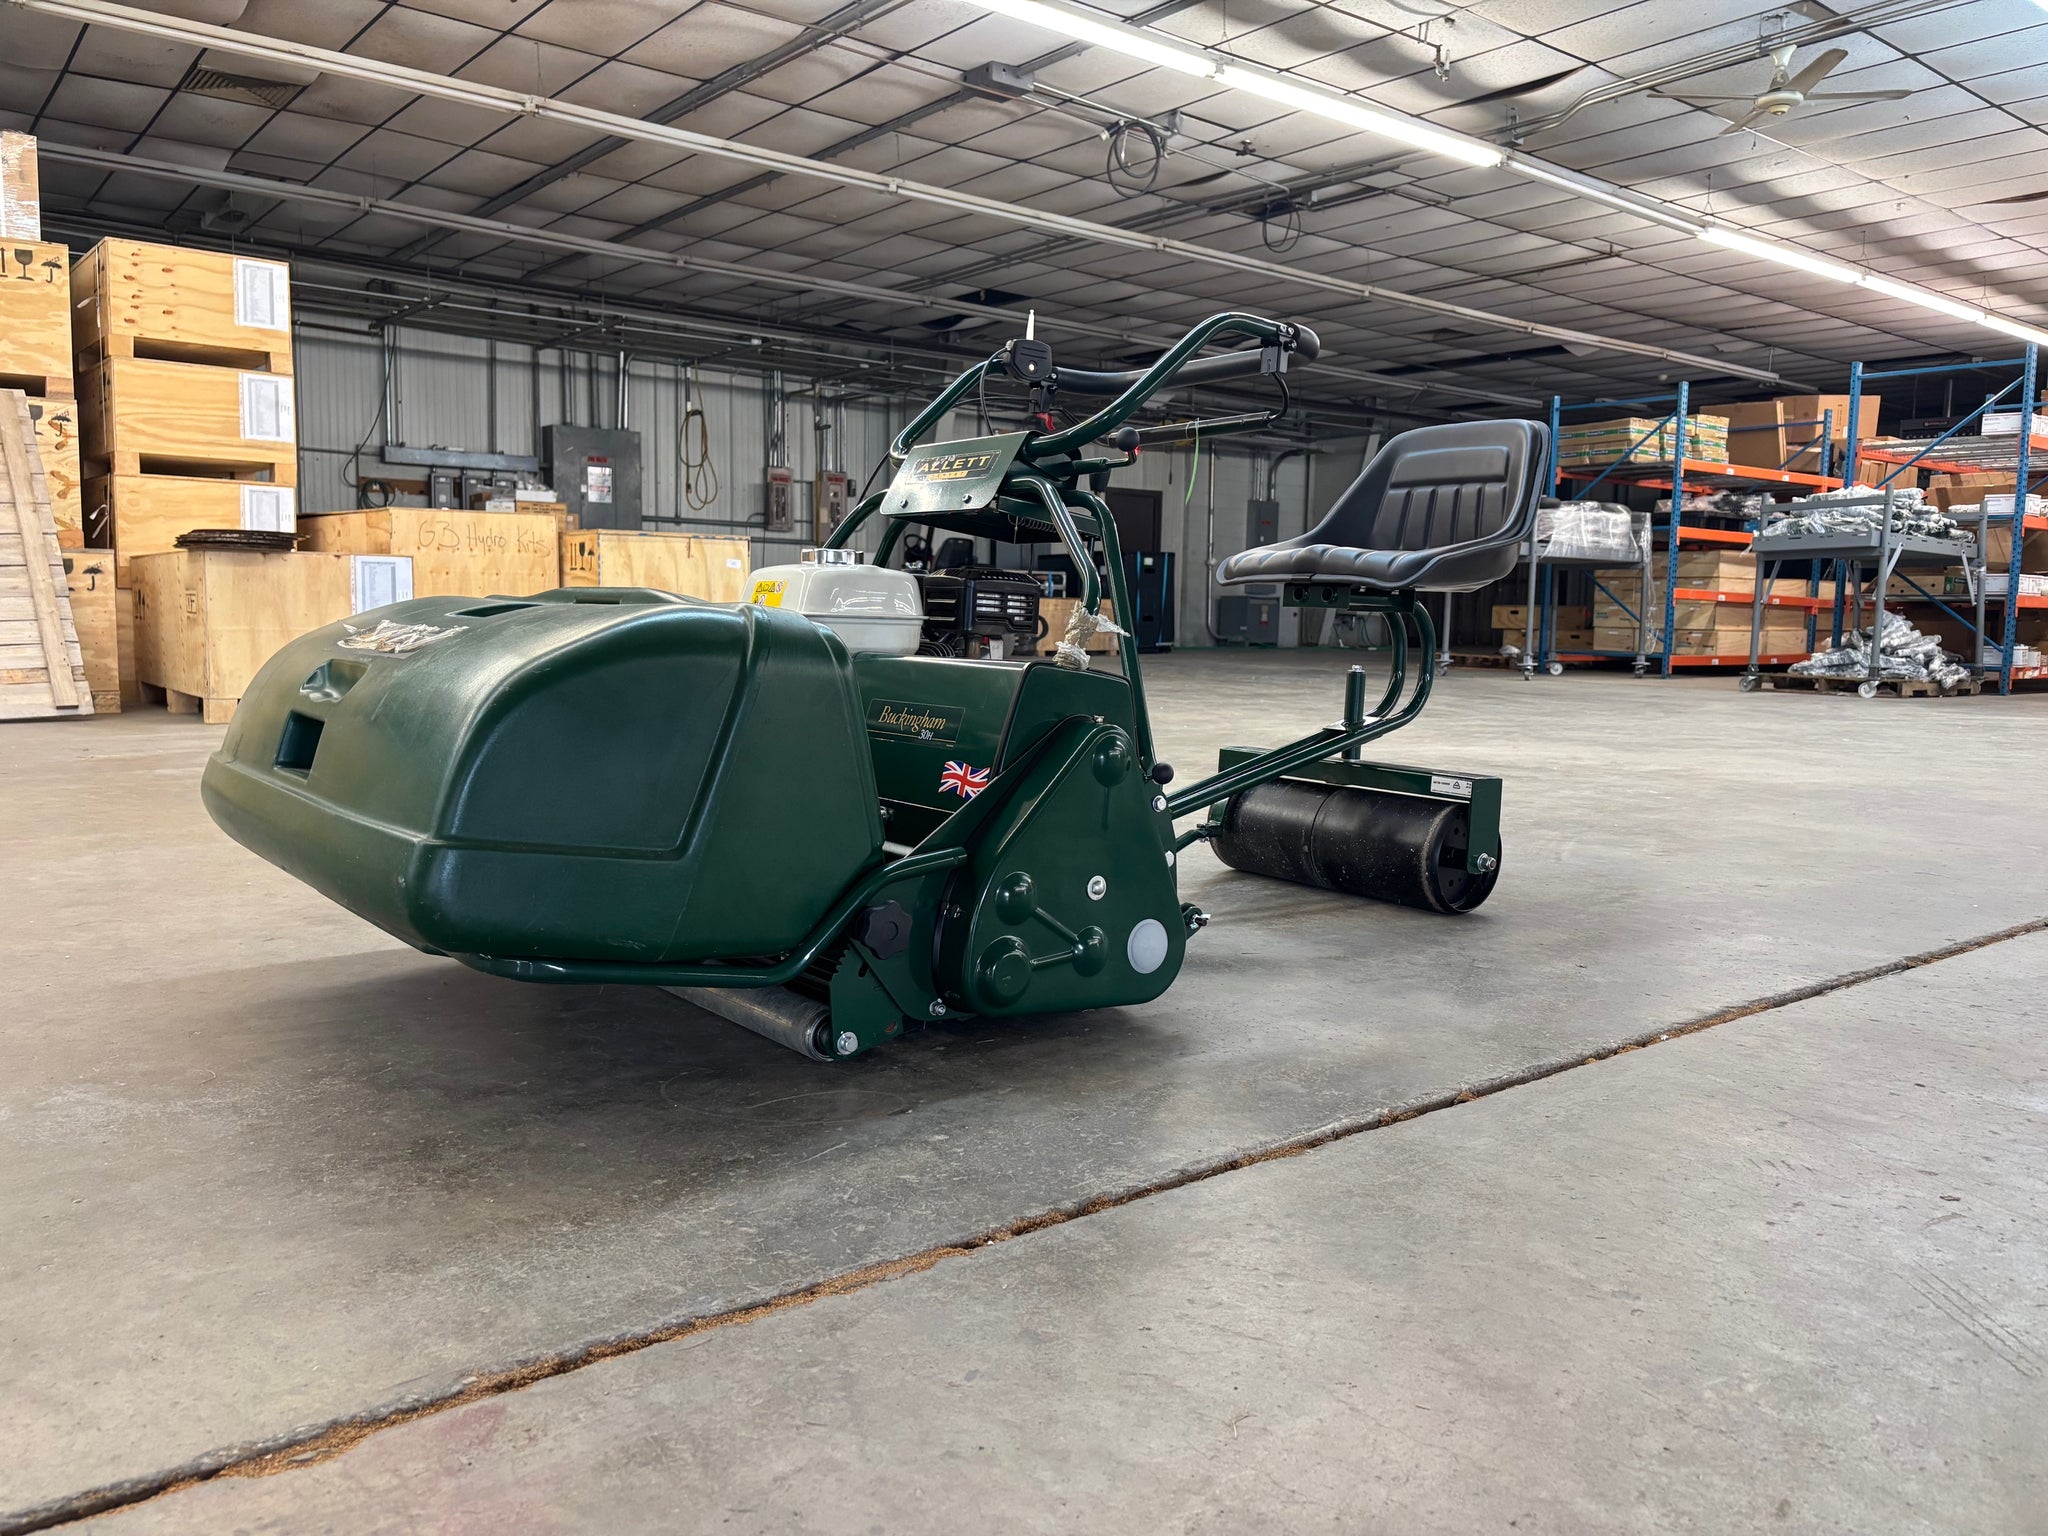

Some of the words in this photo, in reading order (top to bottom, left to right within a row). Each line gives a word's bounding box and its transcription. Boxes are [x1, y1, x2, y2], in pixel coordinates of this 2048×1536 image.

[917, 455, 991, 473] ALLETT
[466, 521, 507, 556] Hydro
[517, 525, 551, 558] Kits
[878, 705, 947, 733] Buckingham
[919, 728, 934, 741] 30H
